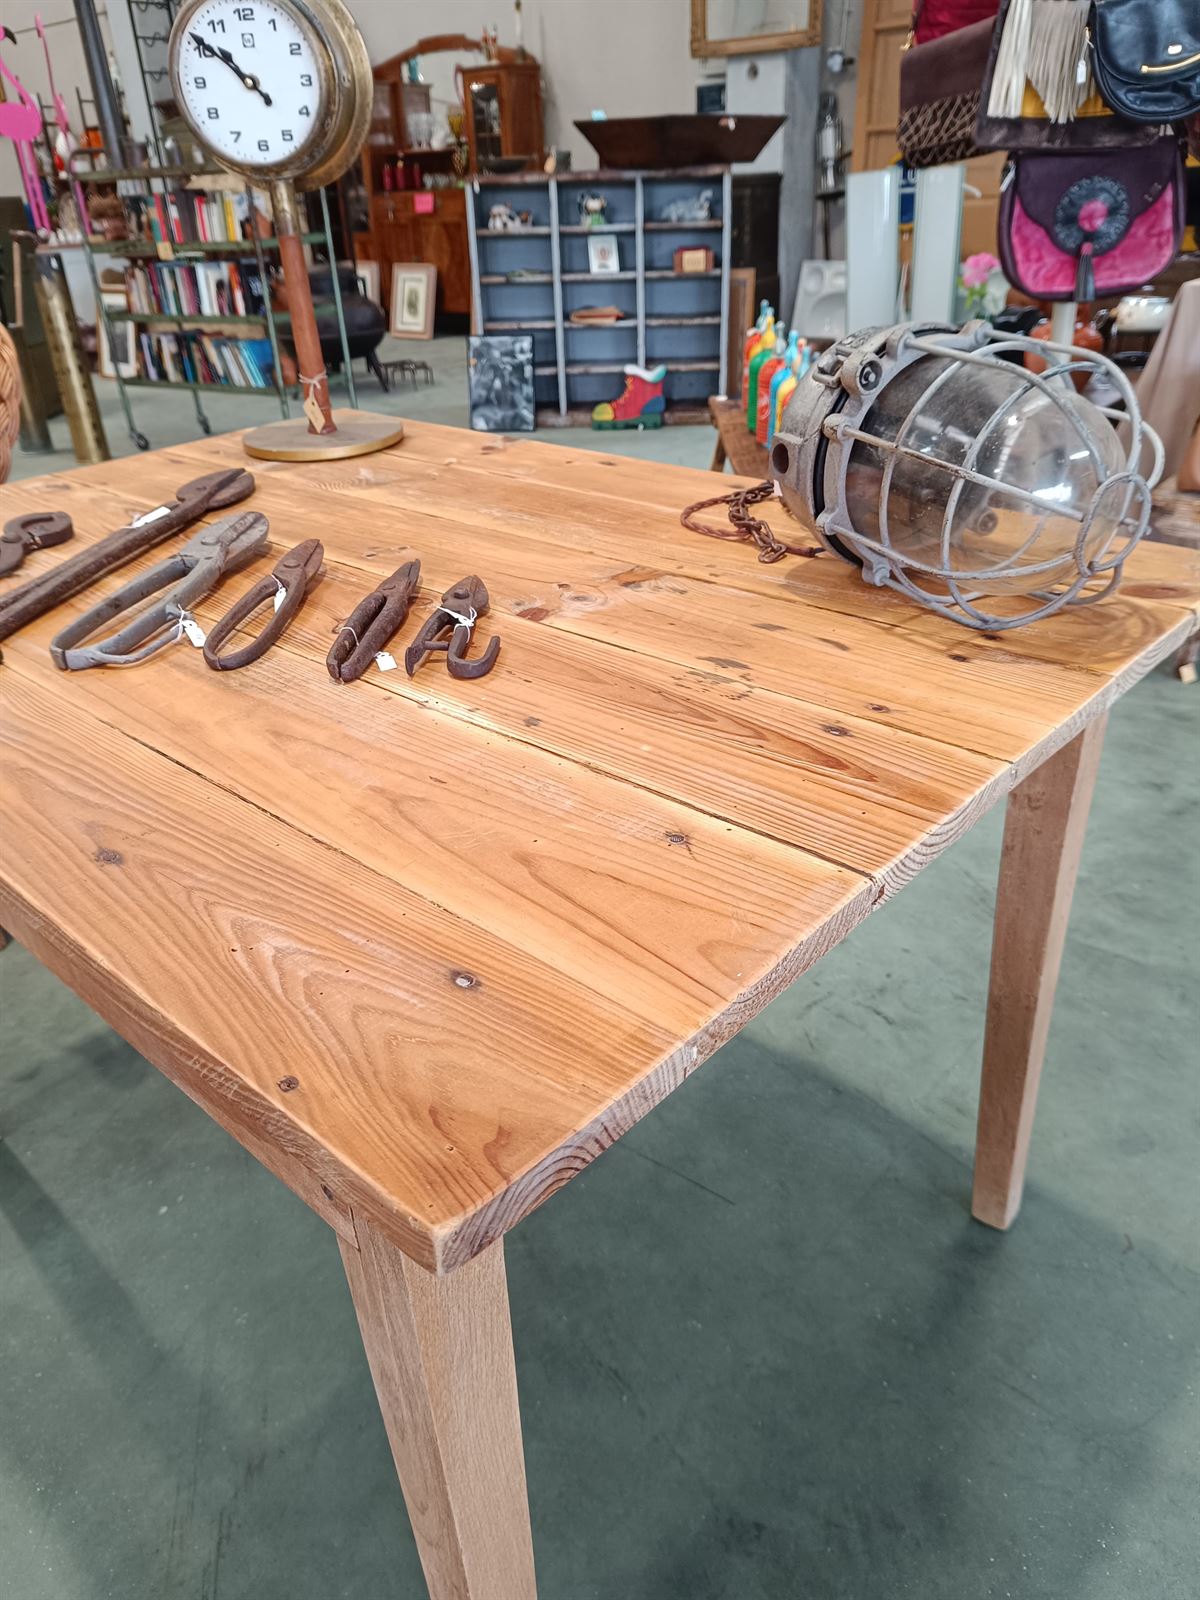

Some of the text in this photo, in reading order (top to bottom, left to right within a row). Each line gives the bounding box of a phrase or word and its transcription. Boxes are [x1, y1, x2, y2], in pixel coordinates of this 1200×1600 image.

[233, 8, 255, 21] 12
[207, 19, 226, 33] 11
[268, 18, 277, 32] 1
[289, 43, 302, 55] 2
[194, 77, 207, 89] 9
[300, 74, 313, 87] 3
[207, 107, 219, 120] 8
[298, 105, 311, 117] 4
[230, 131, 242, 143] 7
[281, 129, 293, 142] 5
[258, 140, 269, 152] 6
